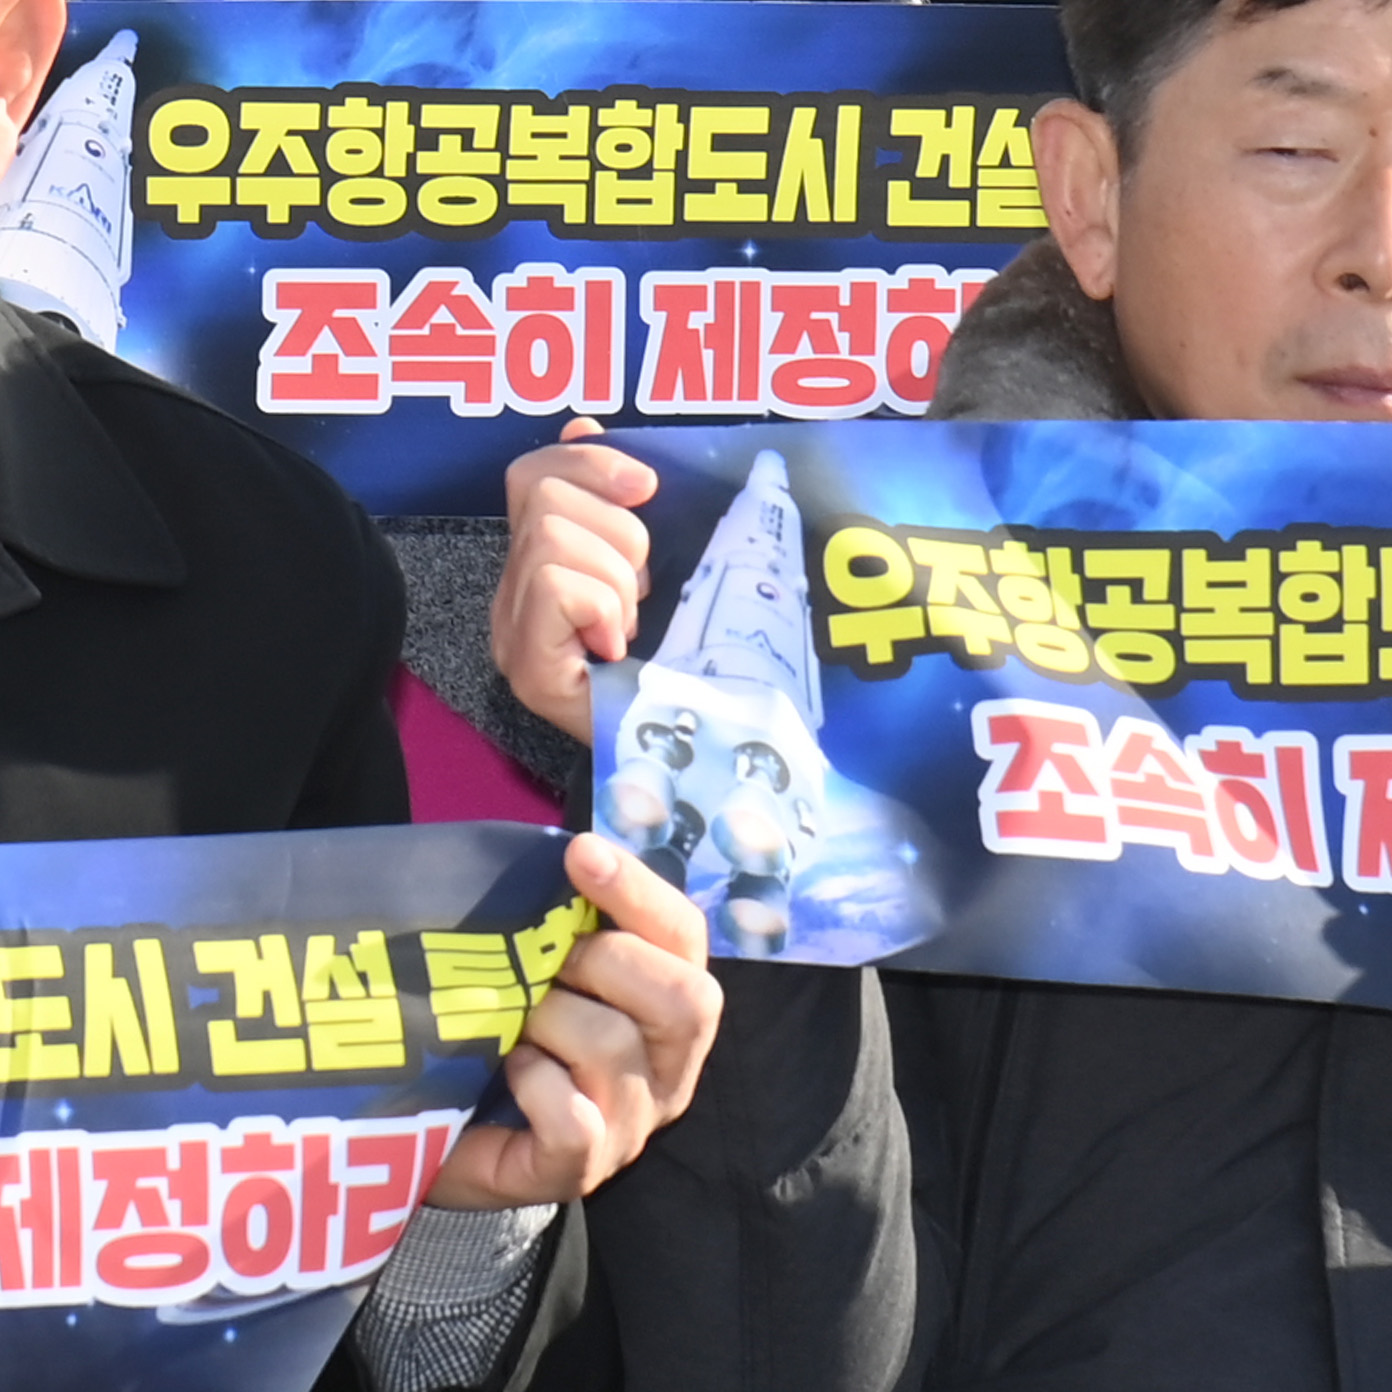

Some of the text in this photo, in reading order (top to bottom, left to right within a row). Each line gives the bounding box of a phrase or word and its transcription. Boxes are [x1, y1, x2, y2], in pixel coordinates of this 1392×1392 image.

[147, 96, 863, 228] 우주항공복합도시
[888, 105, 1050, 228] 건설
[270, 275, 614, 404] 조속히
[986, 702, 1320, 871] 조속히
[197, 929, 407, 1078] 건설
